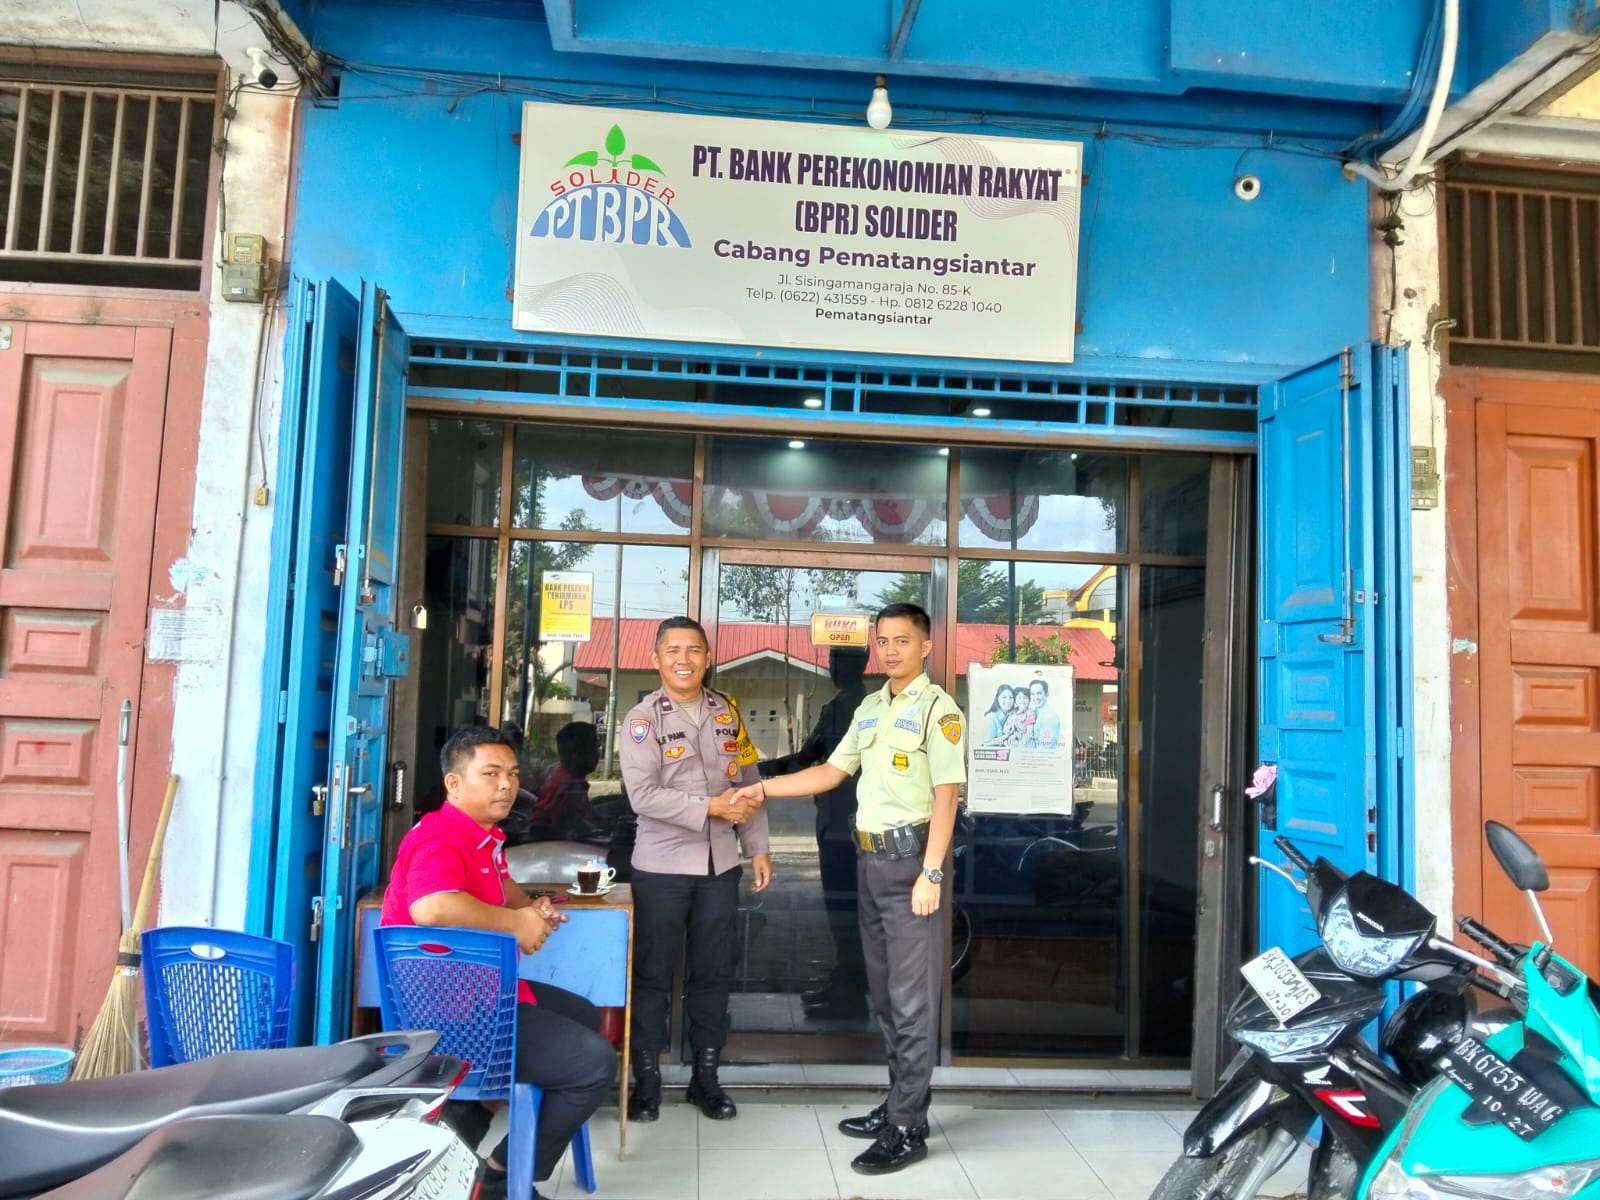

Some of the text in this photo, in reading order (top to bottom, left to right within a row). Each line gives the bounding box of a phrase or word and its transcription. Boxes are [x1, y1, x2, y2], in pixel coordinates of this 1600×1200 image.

[692, 144, 1063, 202] PT. BANK PEREKONOMIAN RAKYAT
[795, 200, 958, 242] (BPR) SOLIDER
[713, 239, 1036, 277] Cabang Pematangsiantar
[777, 273, 972, 296] Jl. Sisingamangaraja No. 85-K
[745, 287, 776, 301] Telp.
[780, 289, 820, 305] (0622)
[823, 293, 867, 306] 431559
[879, 296, 901, 309] Hp.
[904, 297, 934, 310] 0812
[937, 299, 968, 312] 6228
[971, 301, 1002, 314] 1040
[815, 307, 933, 325] Pematangsiantar
[559, 600, 574, 610] LPS
[829, 633, 851, 641] OPEN
[1356, 911, 1385, 933] HONDA
[1453, 1037, 1485, 1064] BK
[1474, 1054, 1527, 1093] 6755
[1517, 1086, 1563, 1122] WAG
